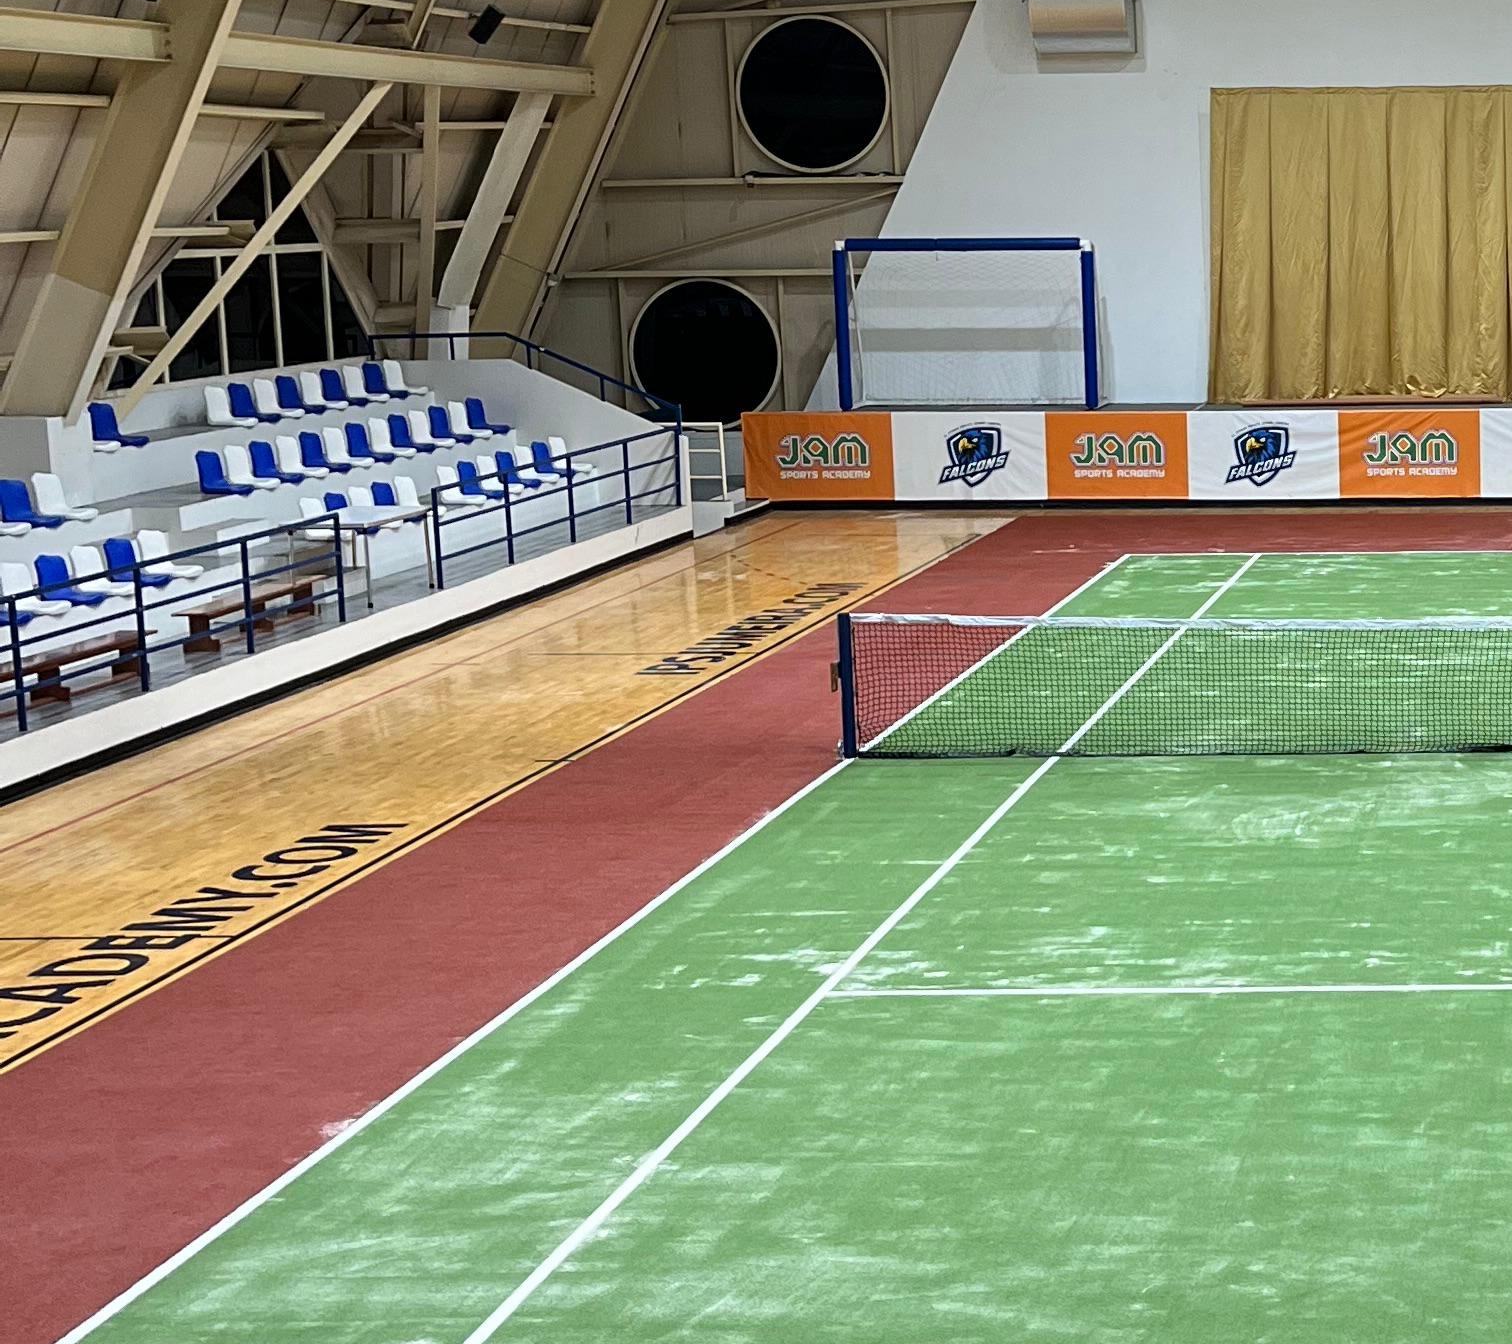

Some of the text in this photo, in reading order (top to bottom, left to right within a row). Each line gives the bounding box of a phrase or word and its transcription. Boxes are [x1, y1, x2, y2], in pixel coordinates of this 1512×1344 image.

[778, 431, 871, 468] JAM
[1071, 431, 1166, 468] JAM
[1362, 429, 1458, 465] JAM
[780, 470, 871, 480] SPORTS ACADEMY
[942, 455, 1006, 479] FALCONS
[1074, 469, 1166, 479] SPORTS ACADEMY
[1229, 455, 1293, 479] FALCONS
[1366, 467, 1458, 477] SPORTS ACADEMY
